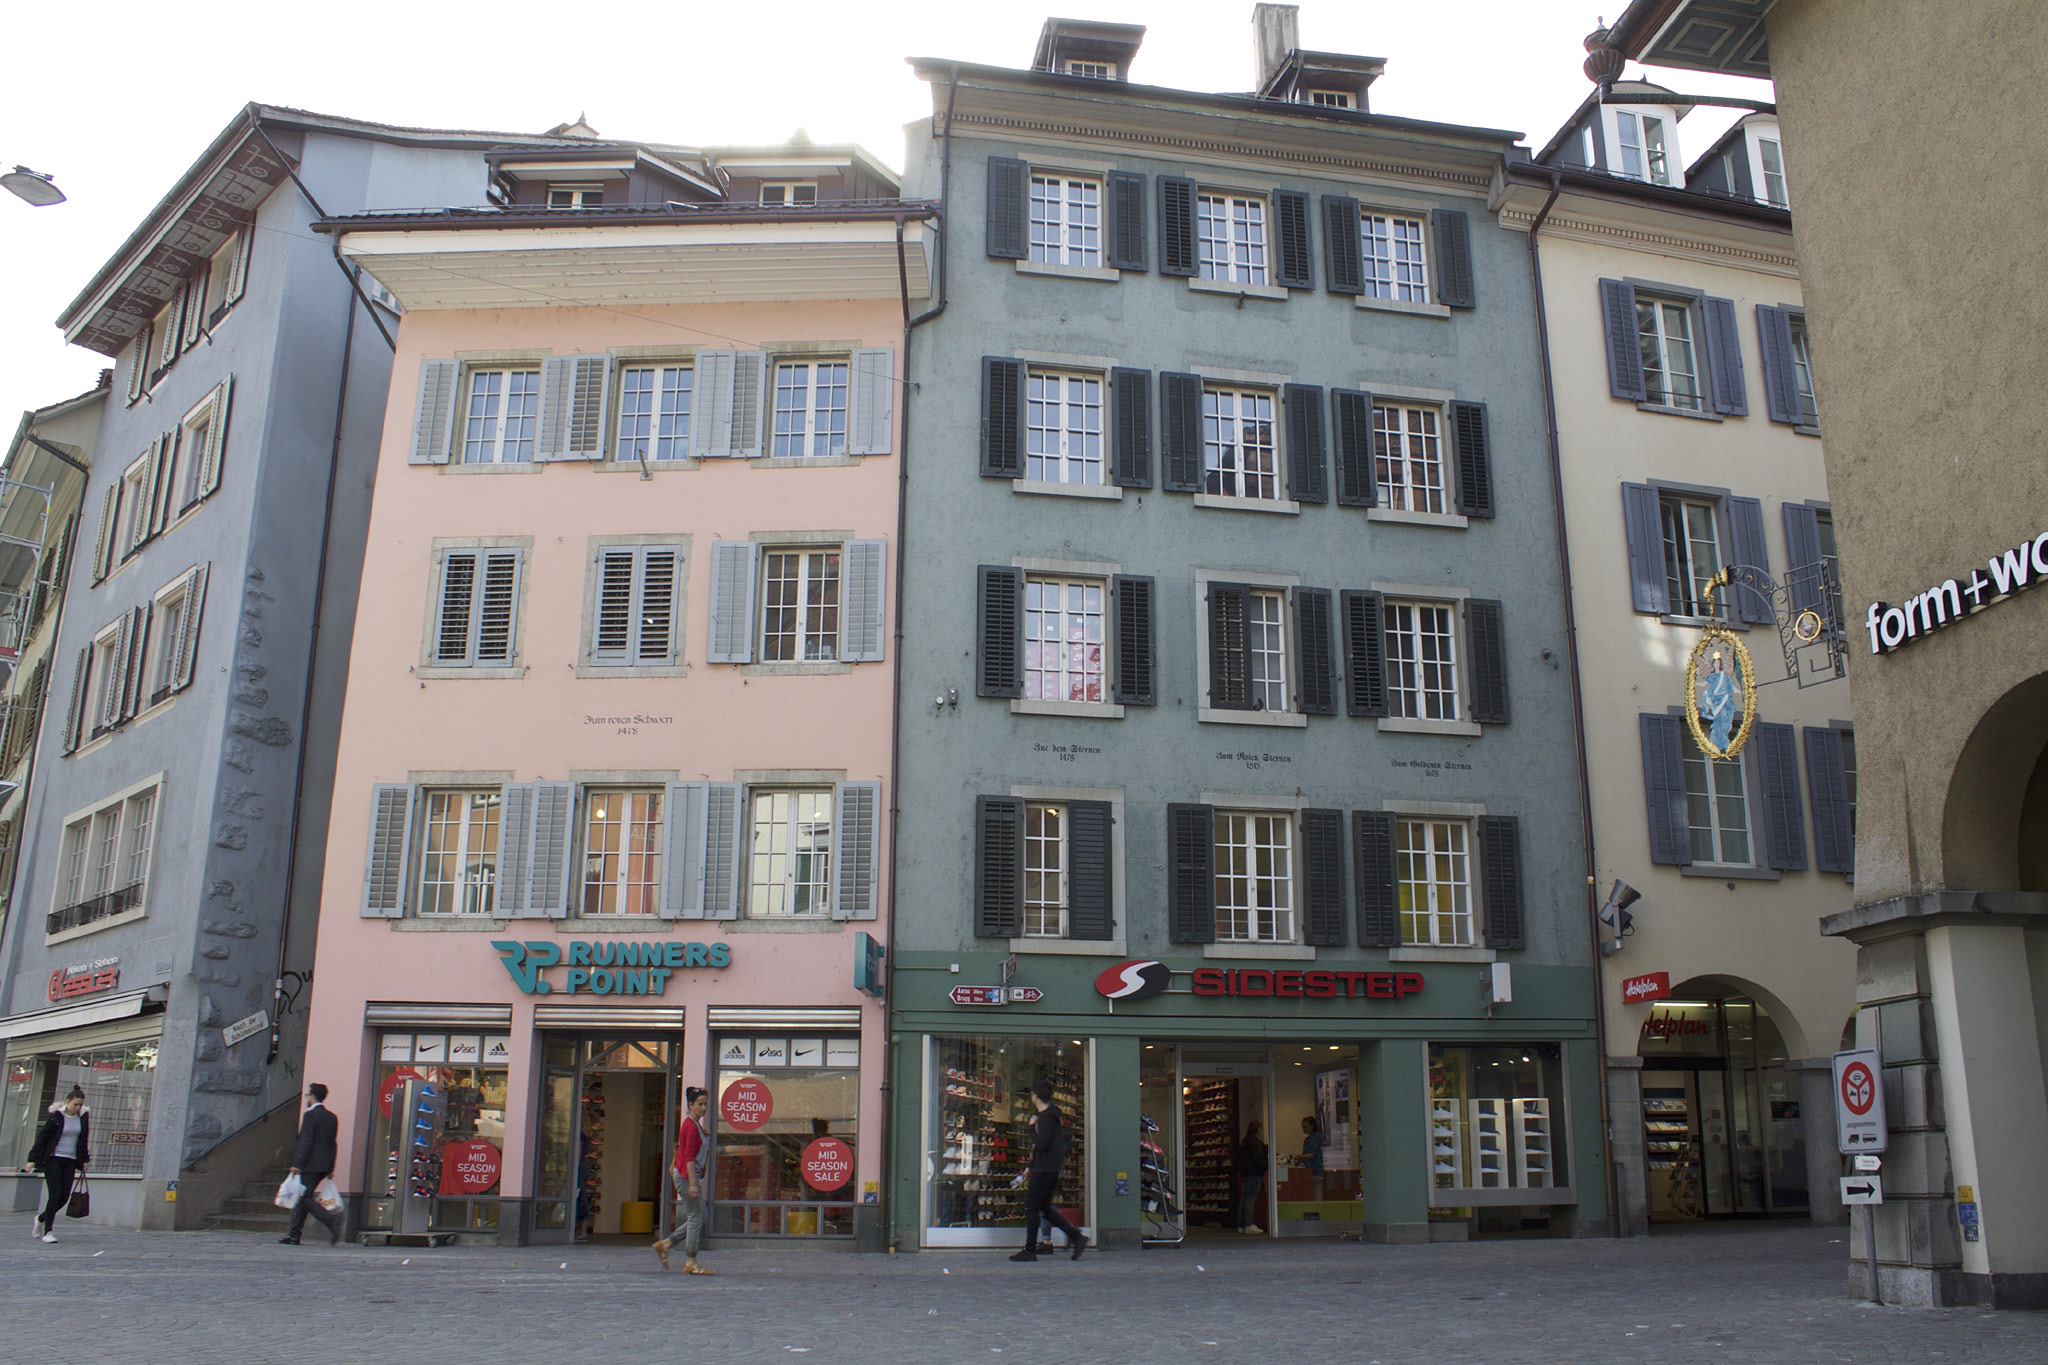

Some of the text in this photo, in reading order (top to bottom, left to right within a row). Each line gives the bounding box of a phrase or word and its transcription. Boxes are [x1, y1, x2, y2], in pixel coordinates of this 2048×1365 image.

[568, 941, 731, 967] RUNNERS
[566, 969, 672, 995] POINT
[1193, 968, 1425, 998] SIDESTEP
[1625, 978, 1659, 998] Hotelplan
[738, 1091, 757, 1101] MID
[726, 1101, 767, 1112] SEASON
[733, 1112, 759, 1123] SALE
[468, 1152, 487, 1162] MID
[818, 1150, 838, 1160] MID
[457, 1163, 496, 1173] SEASON
[807, 1161, 848, 1171] SEASON
[463, 1173, 489, 1183] SALE
[814, 1171, 840, 1181] SALE
